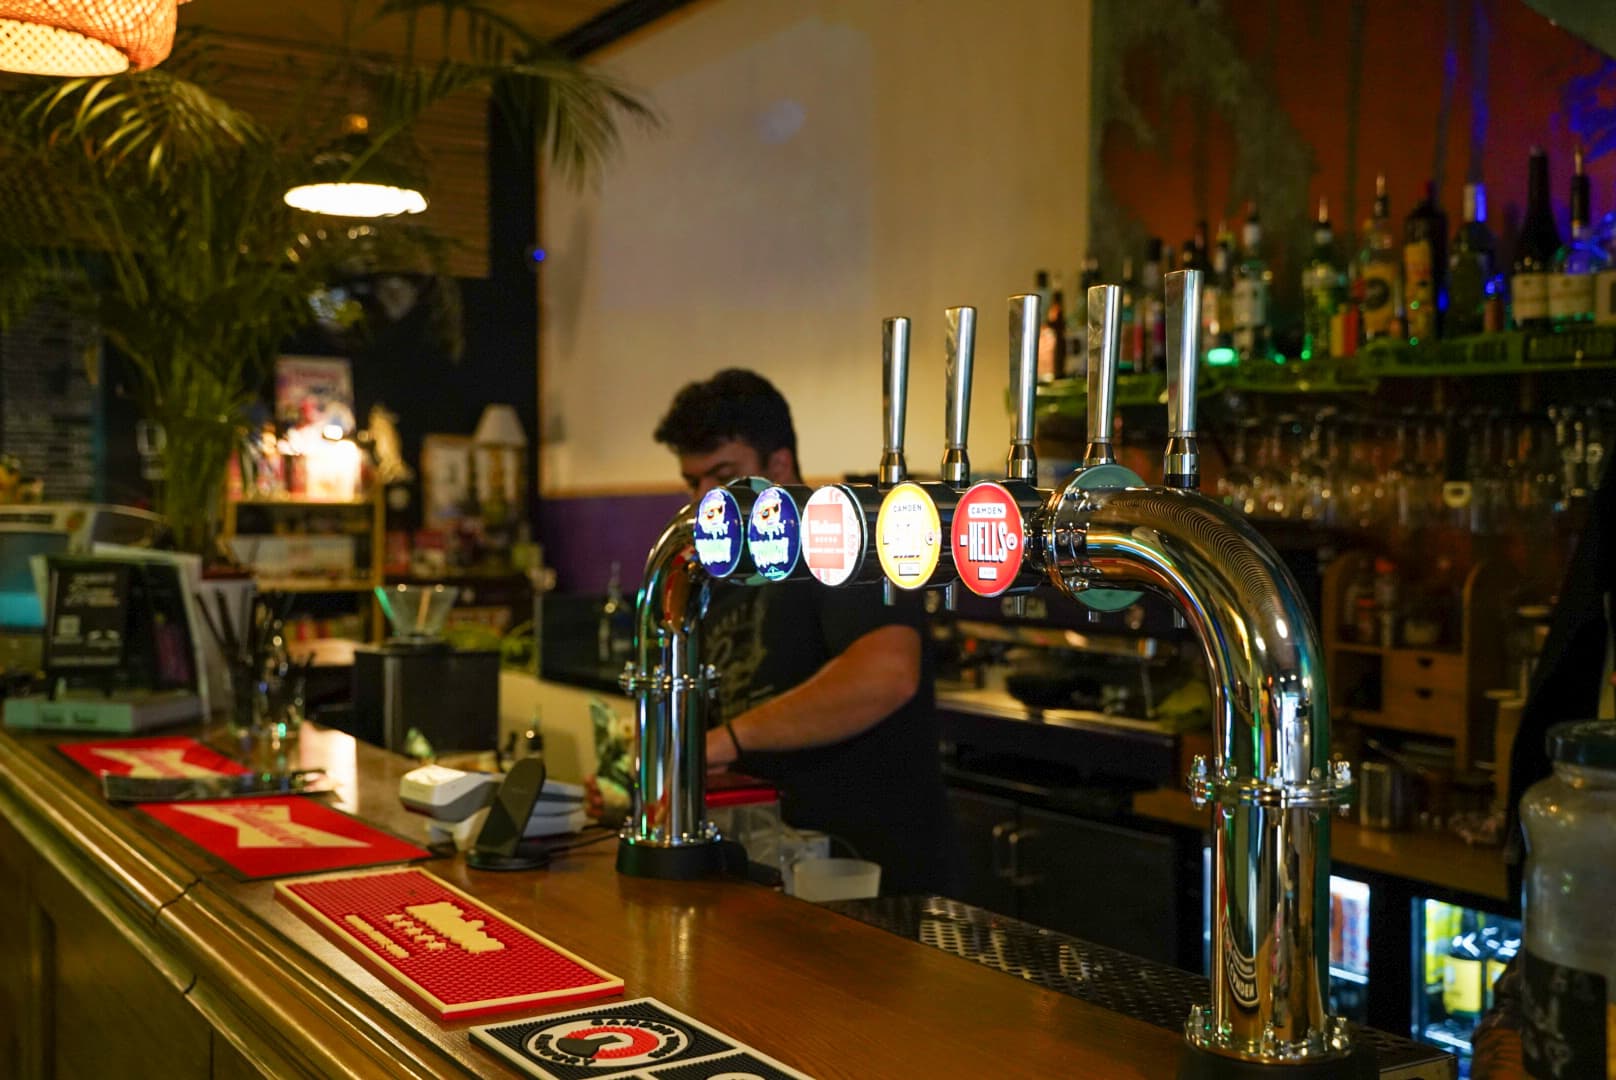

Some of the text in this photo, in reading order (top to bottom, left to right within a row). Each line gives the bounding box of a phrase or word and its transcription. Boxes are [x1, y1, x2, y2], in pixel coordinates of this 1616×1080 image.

[893, 504, 922, 512] CAMDEN
[971, 506, 1003, 515] CAMDEN
[968, 521, 1008, 563] HELLS
